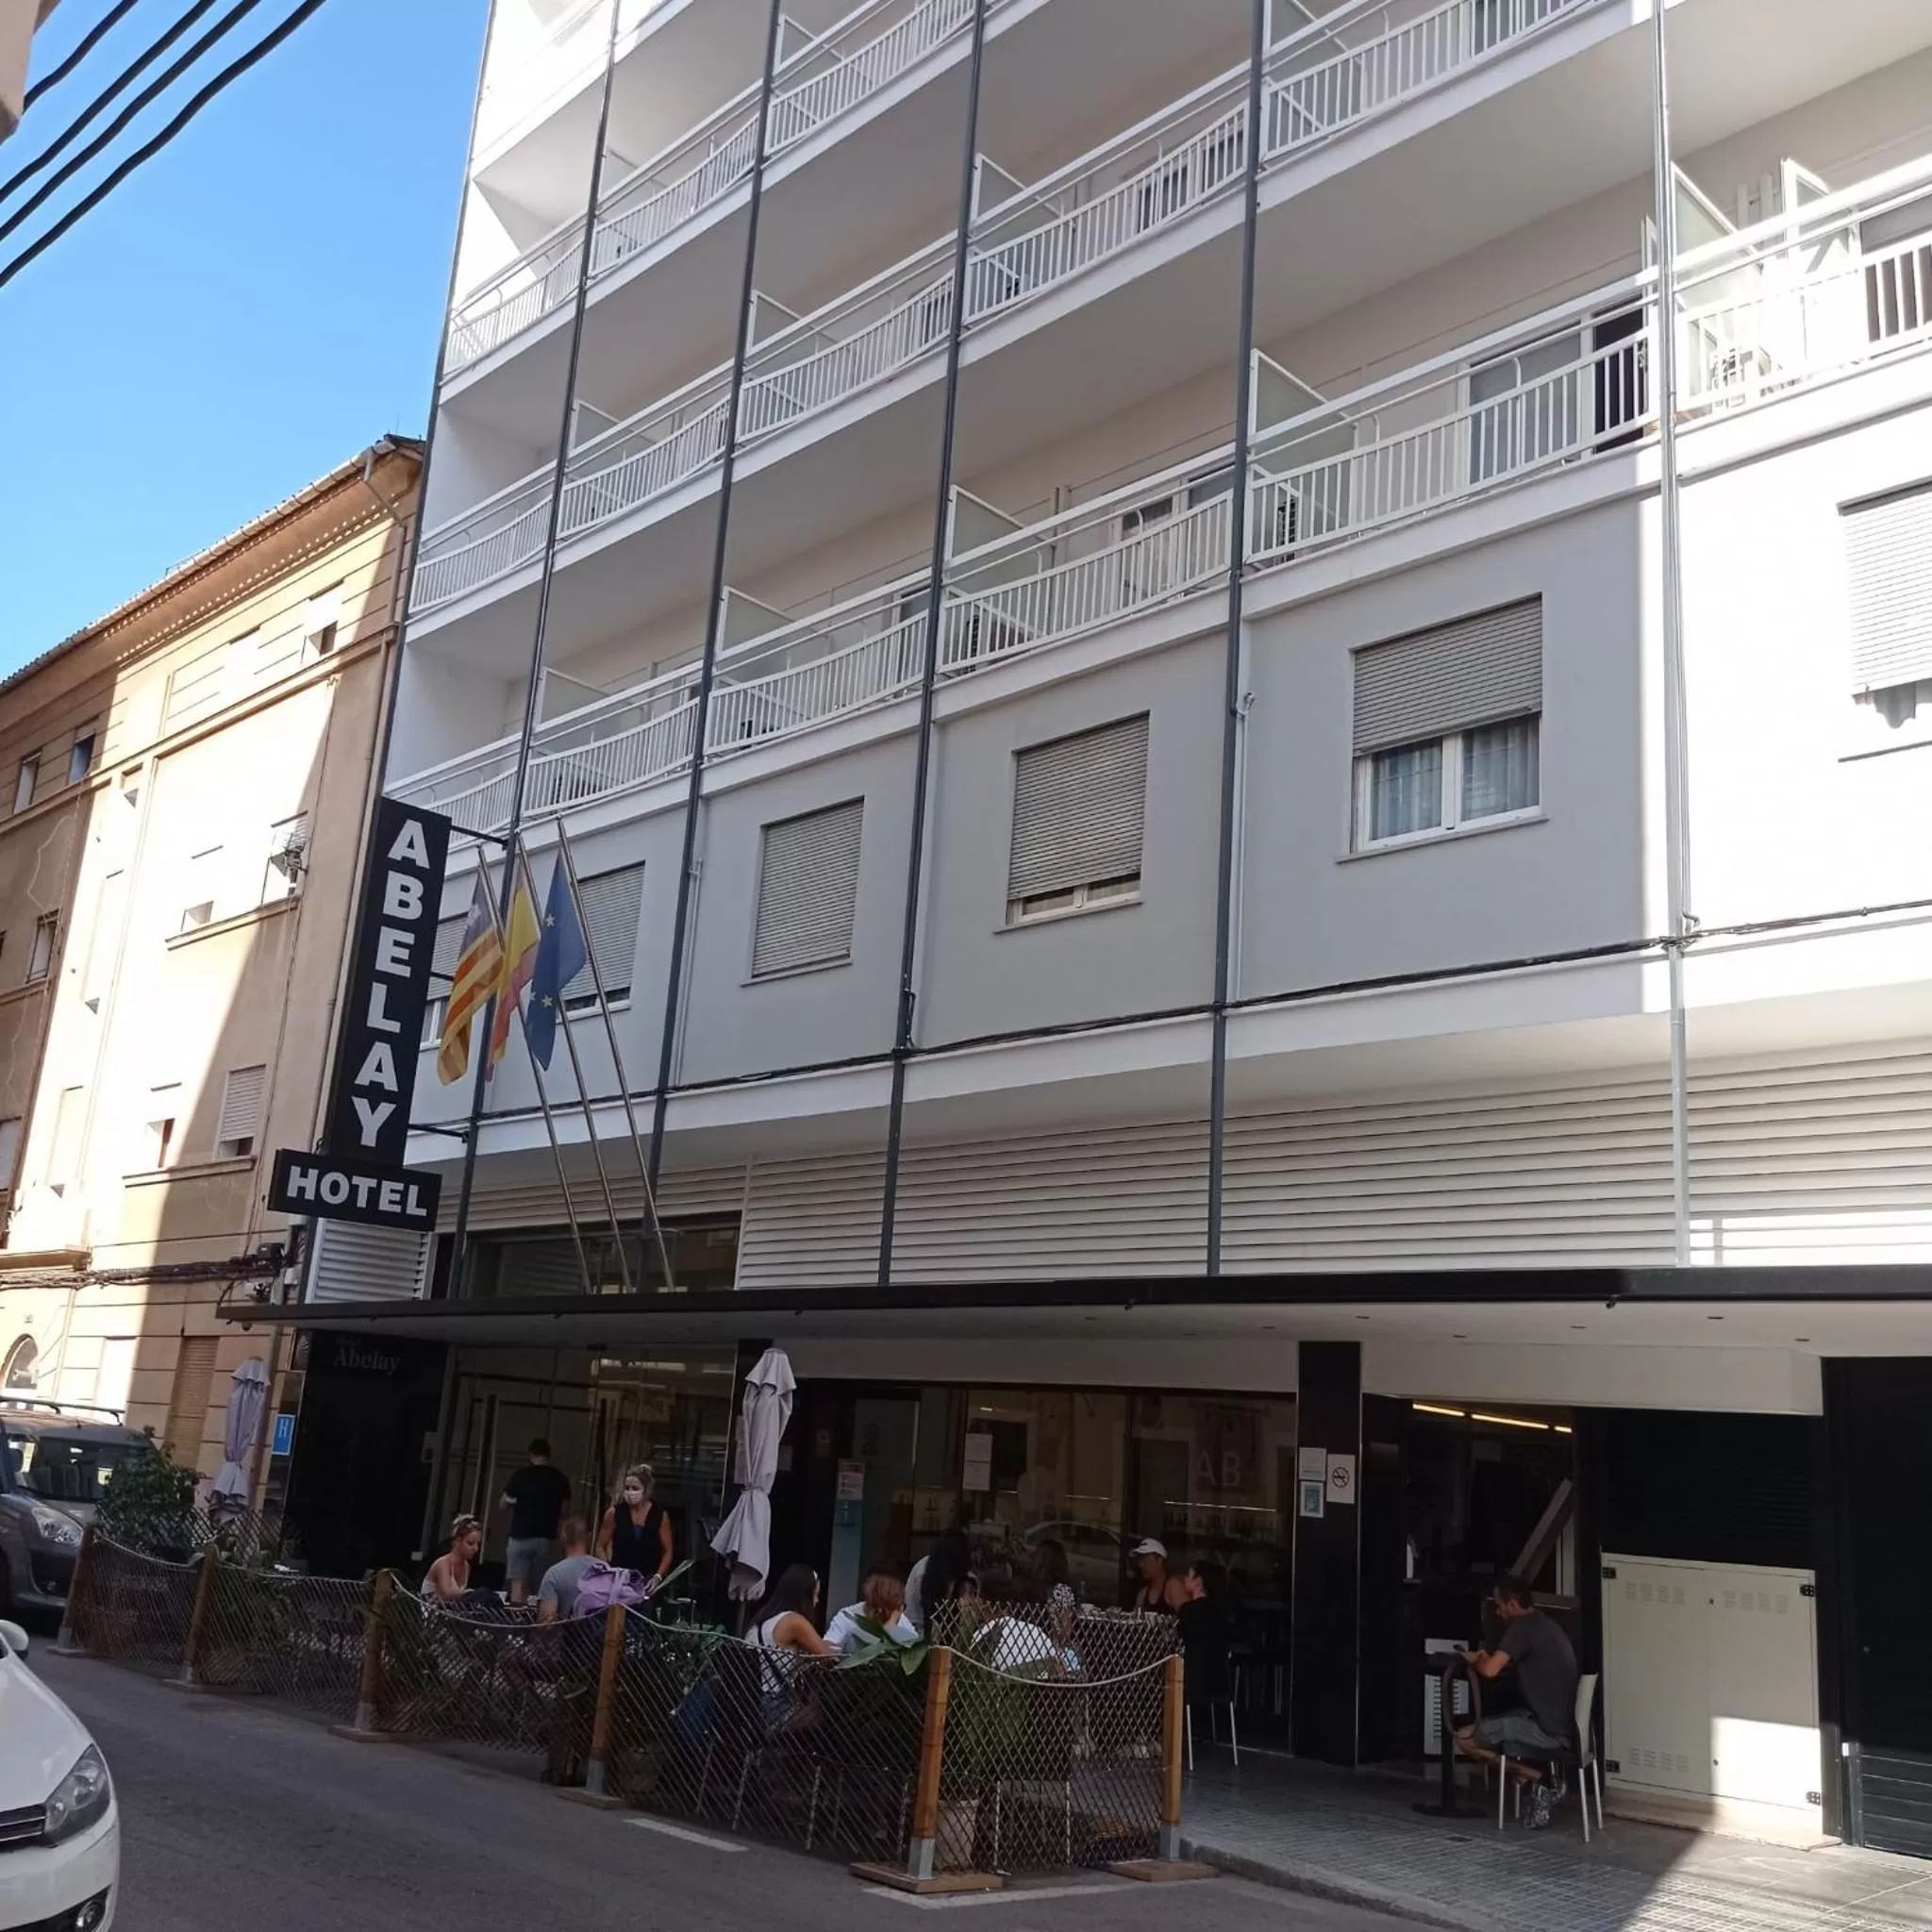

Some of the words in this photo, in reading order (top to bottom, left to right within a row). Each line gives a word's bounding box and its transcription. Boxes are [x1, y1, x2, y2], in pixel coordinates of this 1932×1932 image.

[350, 819, 430, 1148] ABELAY
[286, 1166, 428, 1218] HOTEL
[277, 1417, 290, 1439] H
